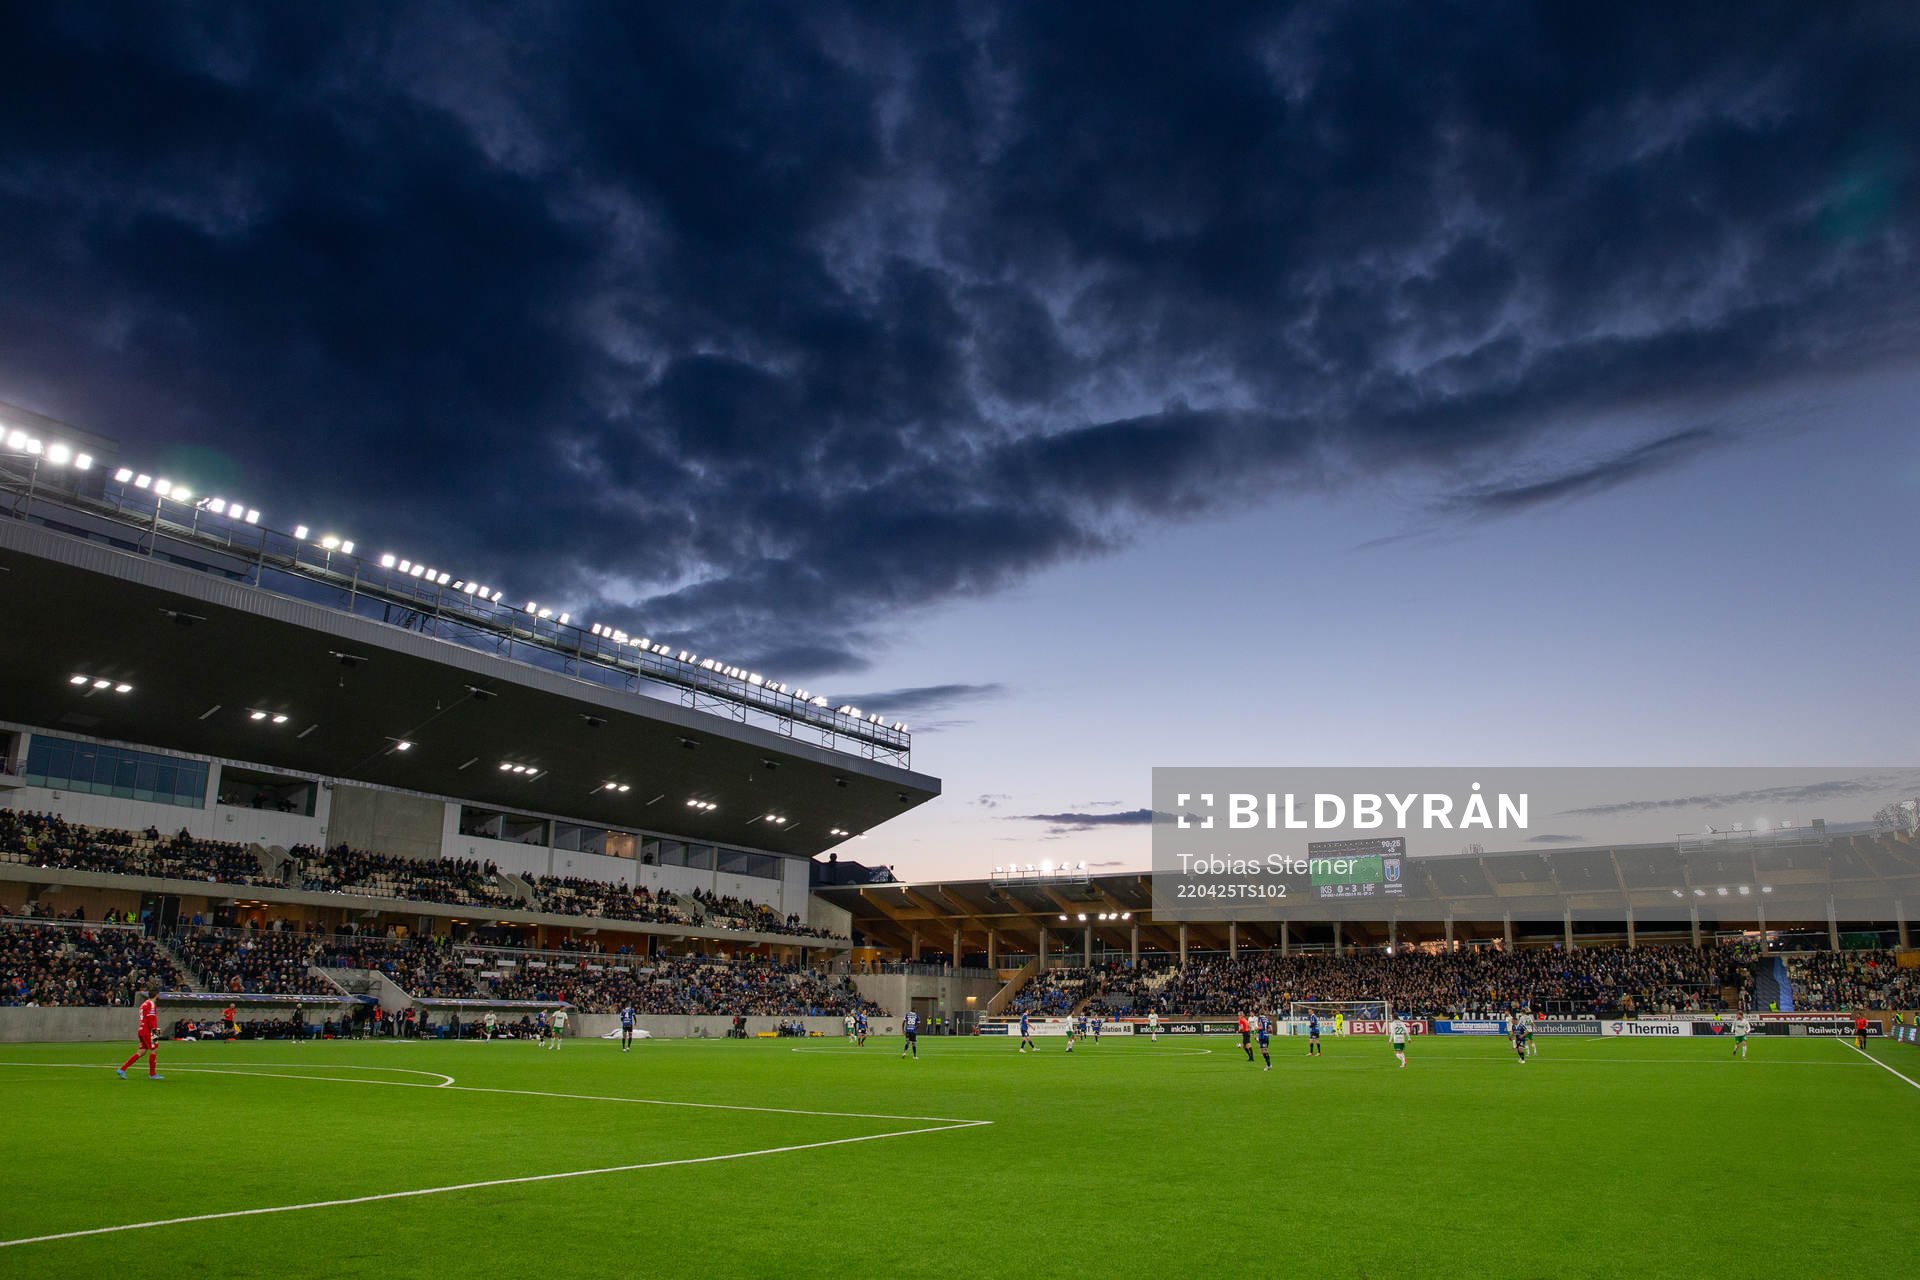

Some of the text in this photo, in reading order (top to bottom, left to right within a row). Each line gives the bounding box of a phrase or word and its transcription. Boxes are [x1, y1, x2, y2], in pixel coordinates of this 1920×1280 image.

[1140, 1025, 1165, 1033] inkub
[1170, 1024, 1197, 1033] inkClub
[1353, 1021, 1424, 1034] BEVGO
[1394, 1026, 1404, 1035] 22
[1626, 1022, 1680, 1035] Thermia
[1808, 1026, 1878, 1035] Railway Syem
